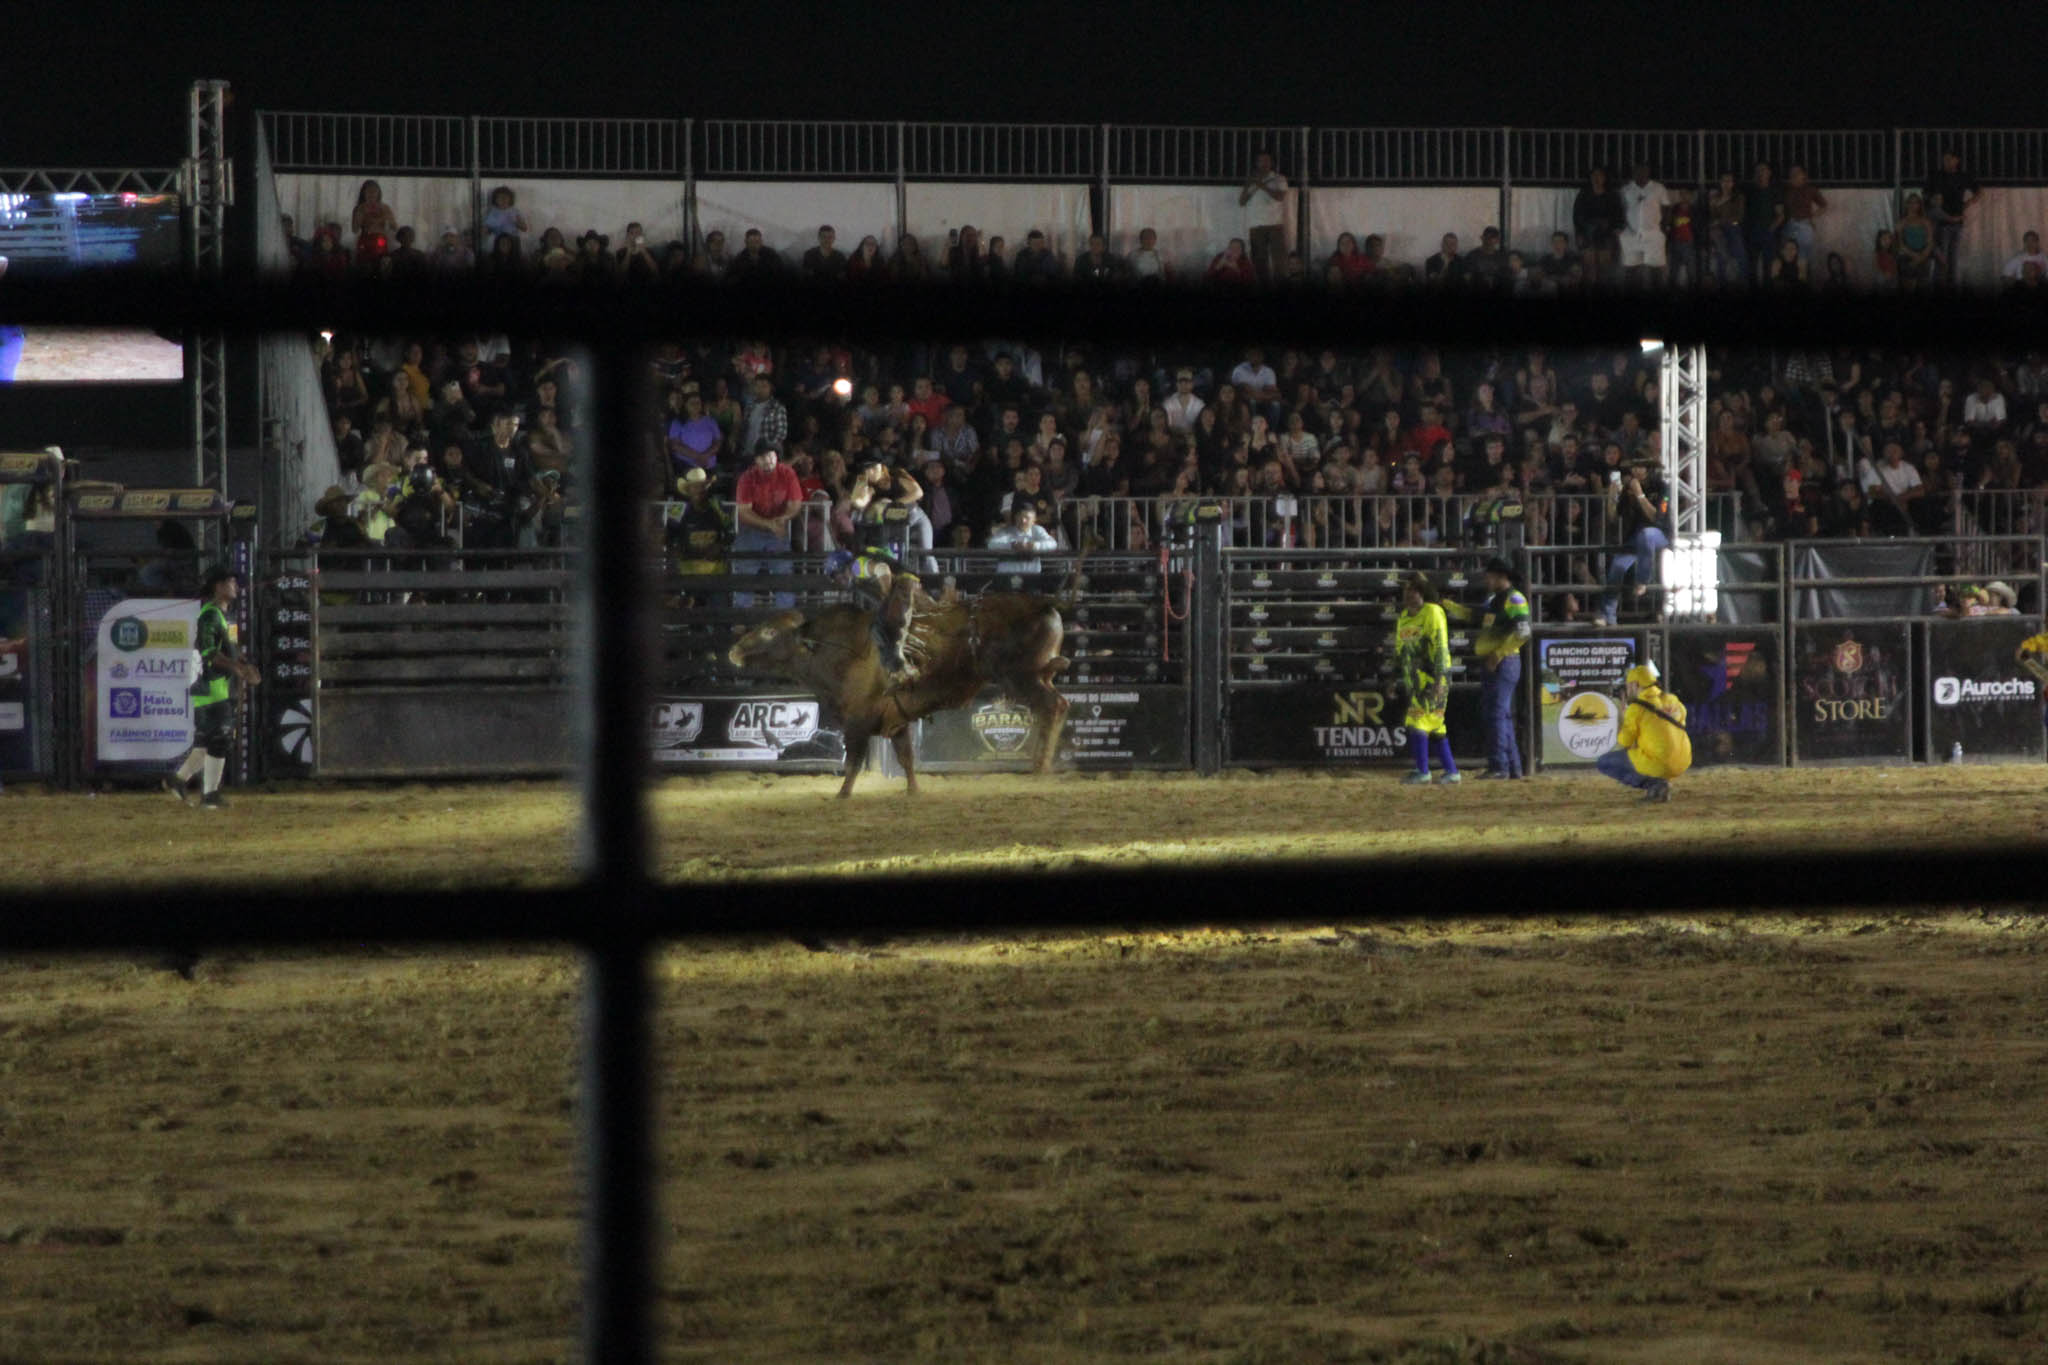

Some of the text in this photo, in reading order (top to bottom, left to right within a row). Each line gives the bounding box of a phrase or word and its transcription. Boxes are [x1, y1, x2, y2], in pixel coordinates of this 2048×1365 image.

[1549, 646, 1629, 656] RANCHO GRUGEL
[135, 658, 188, 673] ALMT
[1549, 658, 1563, 666] EM
[1612, 657, 1627, 665] MT
[1961, 677, 2035, 696] Aurochs
[144, 695, 173, 705] Mato
[1333, 691, 1385, 725] NR
[1815, 697, 1887, 722] STORE
[143, 705, 184, 716] Grosso
[733, 703, 788, 729] ARC
[1313, 727, 1407, 747] TENDAS
[1569, 728, 1613, 753] Grugel
